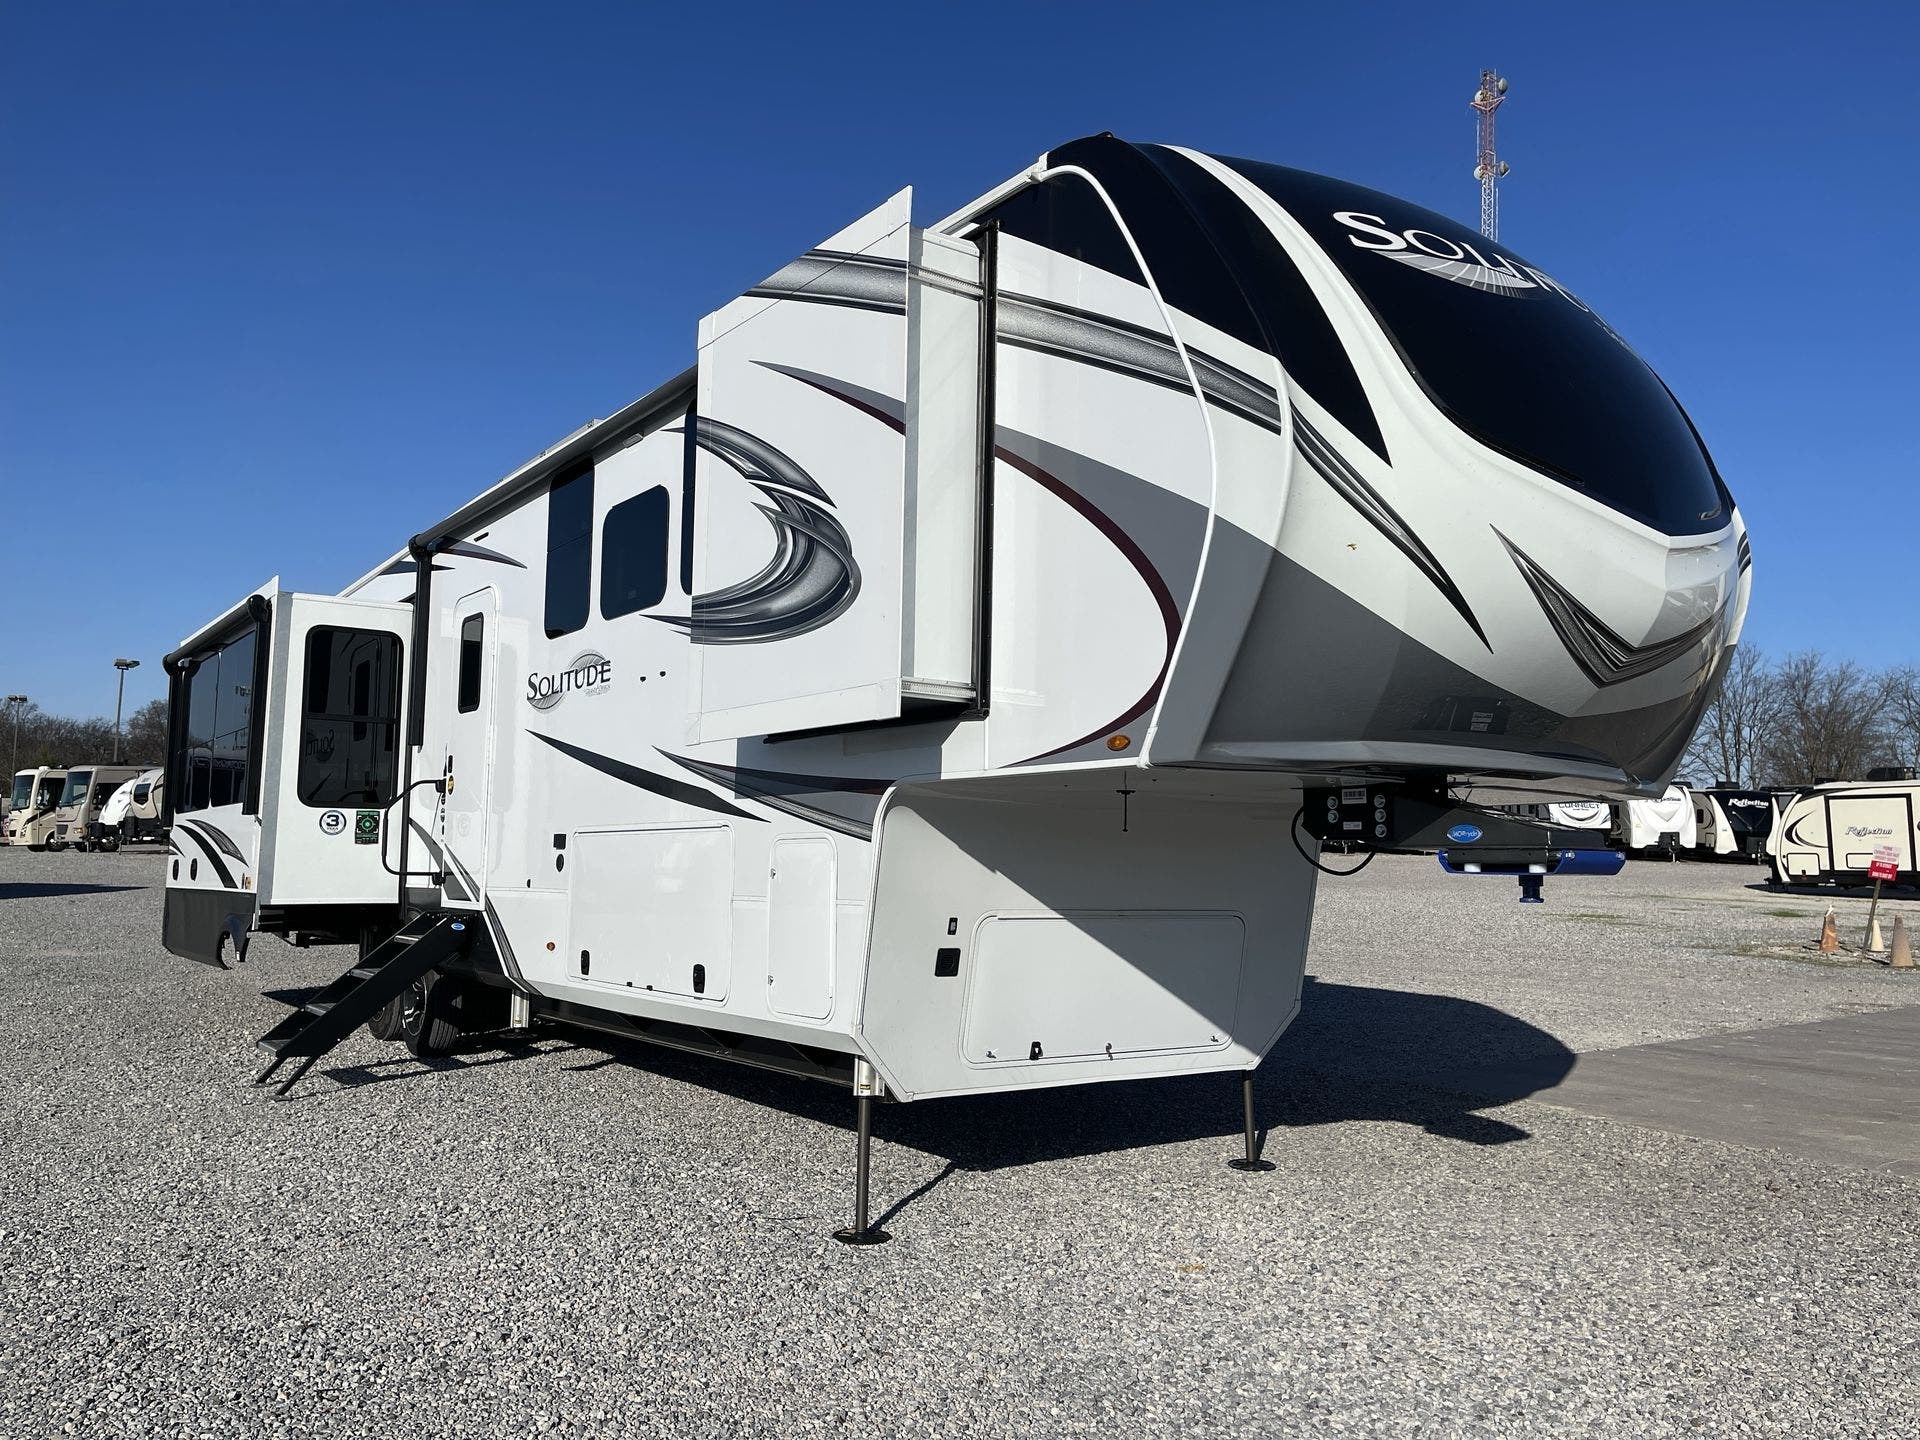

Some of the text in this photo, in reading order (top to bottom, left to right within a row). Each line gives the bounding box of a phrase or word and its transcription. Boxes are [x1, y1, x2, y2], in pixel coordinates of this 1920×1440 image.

[526, 660, 611, 701] SOLITUDE
[1728, 798, 1769, 808] Reflection
[326, 814, 340, 827] 3
[1845, 826, 1893, 837] Reflection
